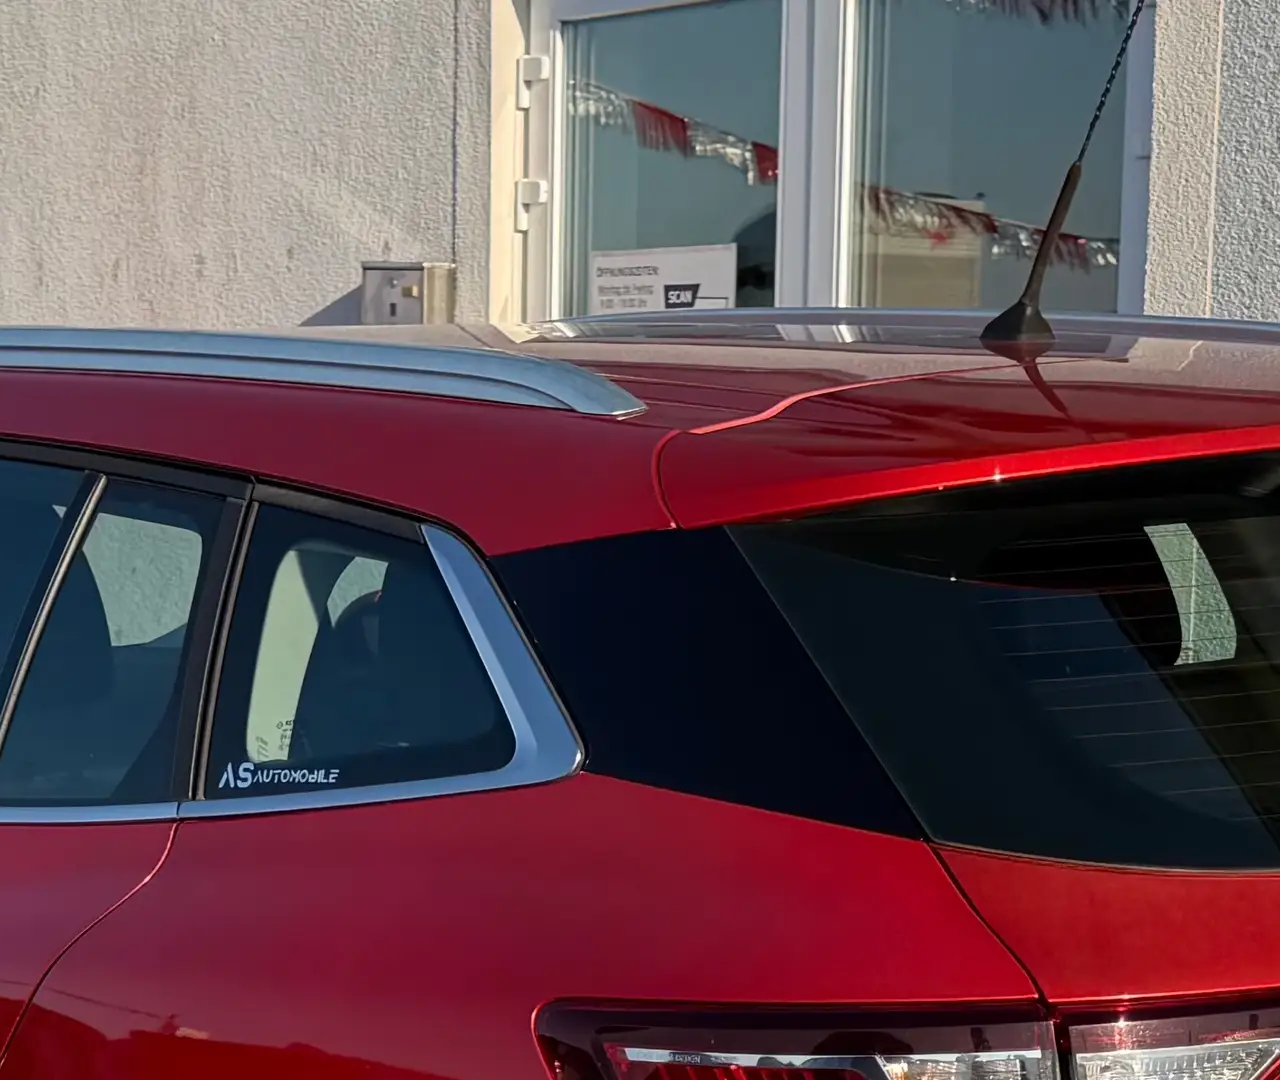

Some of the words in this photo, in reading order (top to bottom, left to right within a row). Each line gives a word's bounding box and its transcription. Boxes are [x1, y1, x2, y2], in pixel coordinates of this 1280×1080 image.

[667, 290, 693, 304] SCAN
[218, 761, 255, 789] AS
[253, 769, 340, 784] AUTOMOBILE
